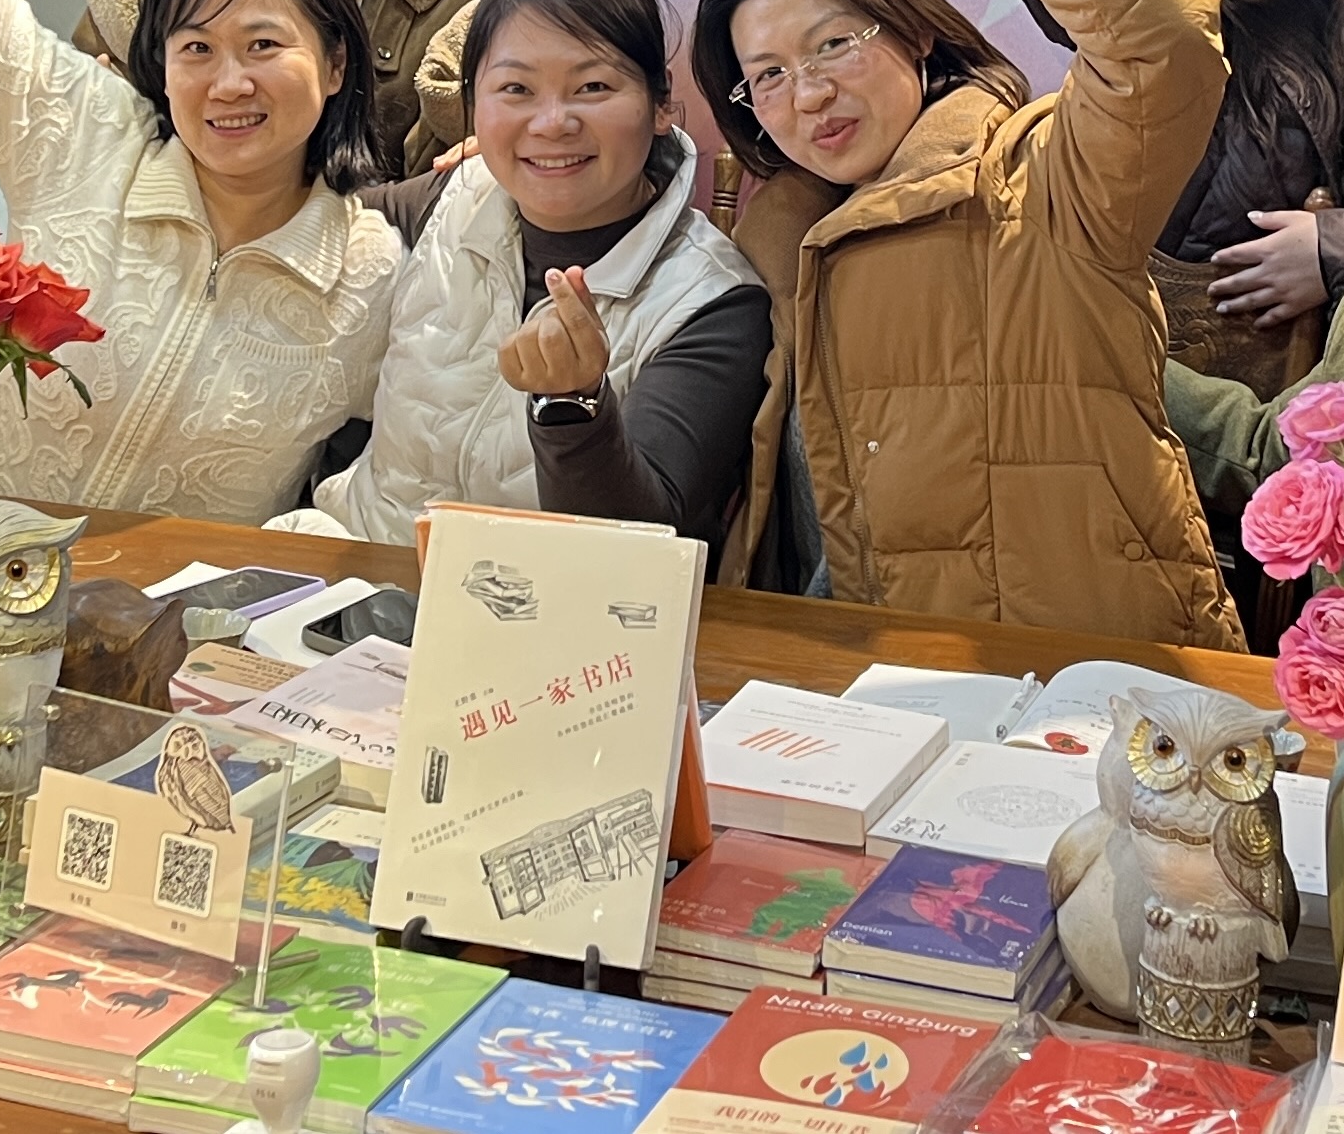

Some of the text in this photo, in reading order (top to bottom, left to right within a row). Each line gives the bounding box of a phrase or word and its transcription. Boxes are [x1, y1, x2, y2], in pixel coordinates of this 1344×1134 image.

[459, 652, 633, 742] 遇见一家书店
[842, 921, 893, 937] Demian
[766, 994, 978, 1038] Natalia Ginzburg
